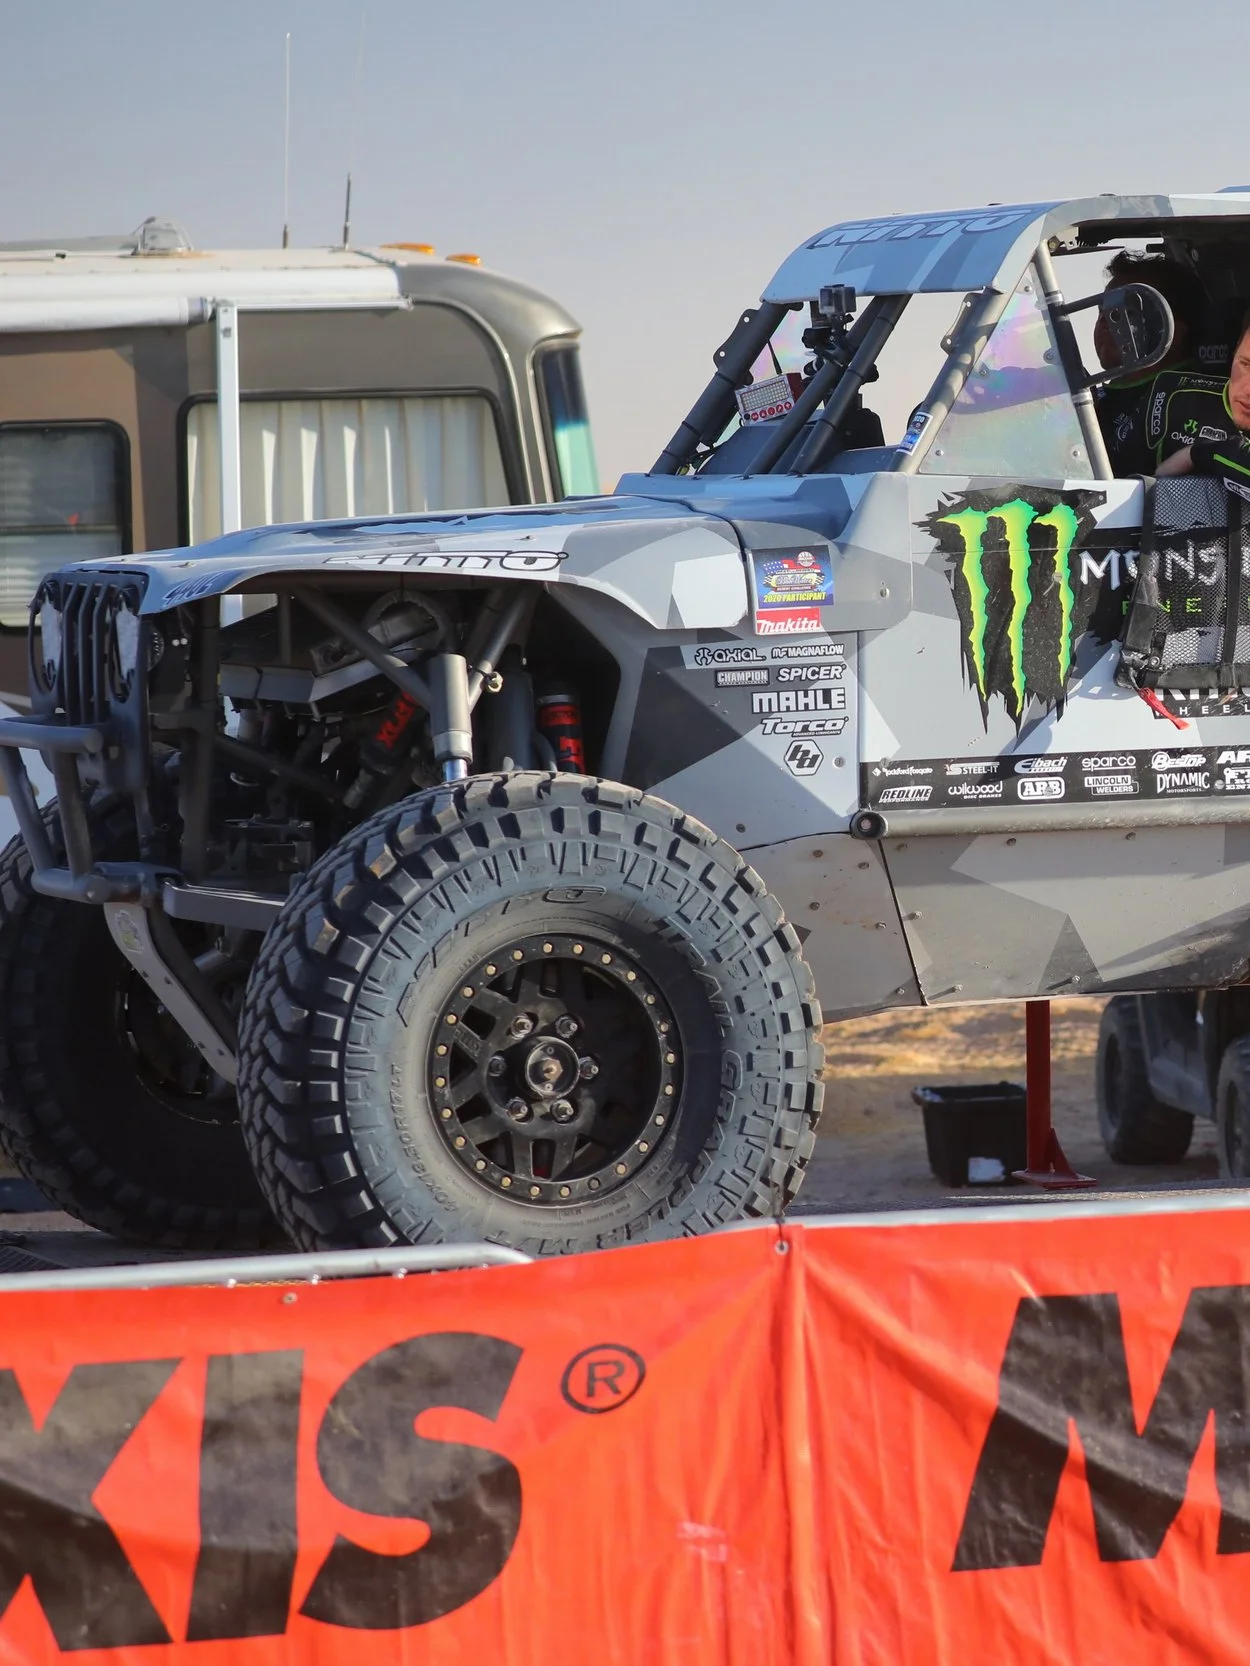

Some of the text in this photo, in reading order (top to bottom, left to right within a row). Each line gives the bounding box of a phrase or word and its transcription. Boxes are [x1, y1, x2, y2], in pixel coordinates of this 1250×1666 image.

[764, 592, 827, 603] 2020 PARTICIPANT
[787, 644, 844, 658] MAGNAFLOW
[717, 671, 769, 683] CHAMPION
[777, 666, 844, 682] SPICER
[752, 688, 846, 714] MAHLE
[963, 764, 999, 775] STEEL-IT
[1082, 756, 1137, 772] sparco
[948, 780, 1003, 796] wilwood
[1022, 780, 1062, 796] ARB
[1087, 777, 1129, 786] LINCOLN
[1156, 772, 1210, 794] DYNAMIC
[882, 788, 930, 799] REDLINE
[1096, 786, 1134, 794] WELDERS
